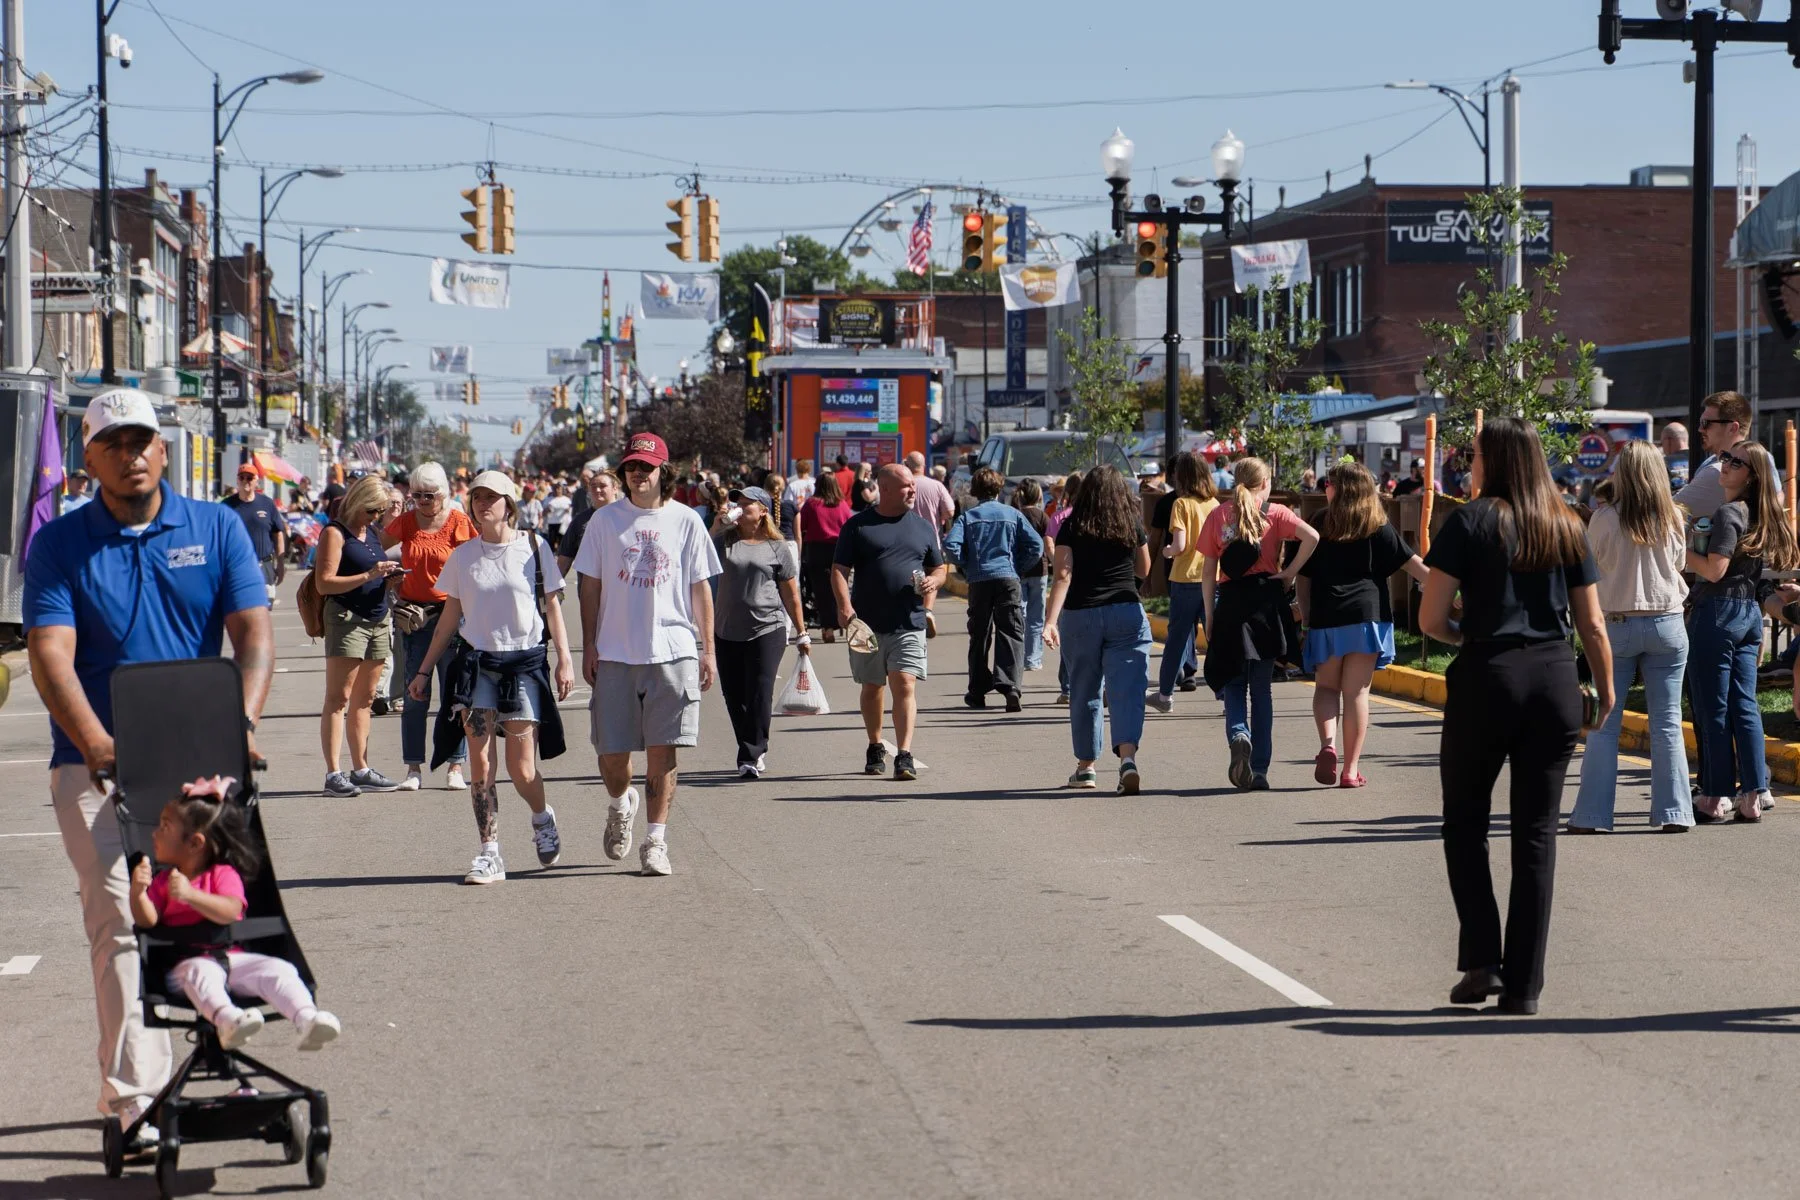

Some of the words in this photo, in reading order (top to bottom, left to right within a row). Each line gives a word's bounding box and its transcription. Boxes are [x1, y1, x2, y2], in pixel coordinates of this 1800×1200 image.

[1435, 210, 1550, 226] GAAE
[1011, 211, 1022, 263] FIRS
[1390, 224, 1550, 242] TWENYIX
[460, 271, 499, 286] UNITED
[840, 312, 871, 321] SIGNS
[825, 393, 874, 406] $1,429,440
